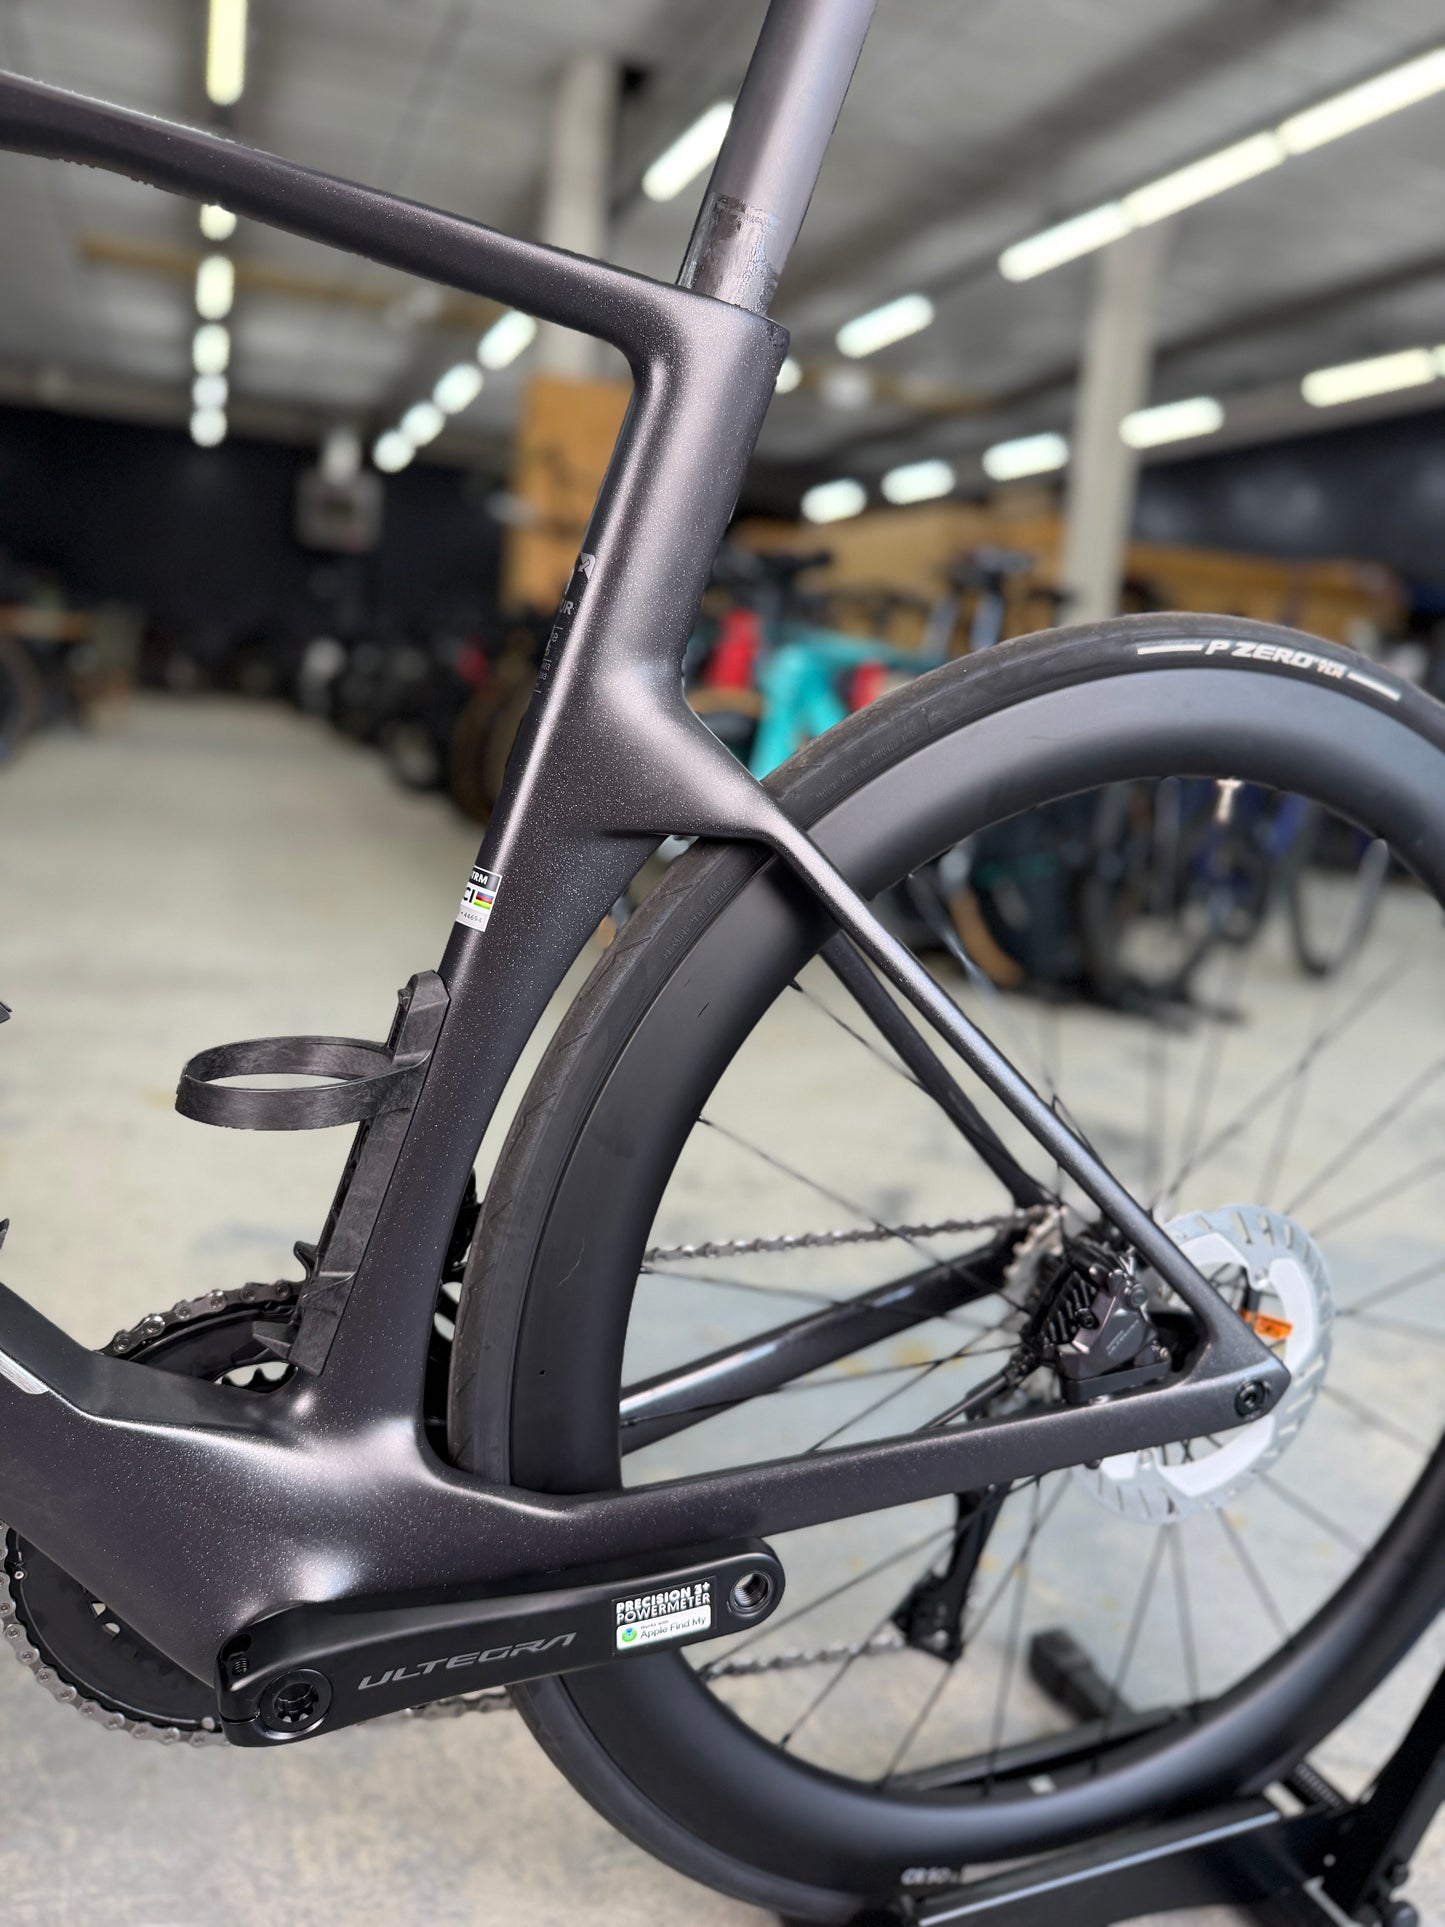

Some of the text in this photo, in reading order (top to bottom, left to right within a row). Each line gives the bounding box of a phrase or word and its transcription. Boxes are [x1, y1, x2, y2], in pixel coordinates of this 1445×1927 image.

[1205, 639, 1231, 655] P
[1231, 642, 1315, 669] ZERO
[616, 1582, 711, 1614] PRECISION 3+
[616, 1592, 711, 1626] POWERMETER
[640, 1615, 706, 1639] Apple Find My
[357, 1632, 577, 1691] ULTEGRA
